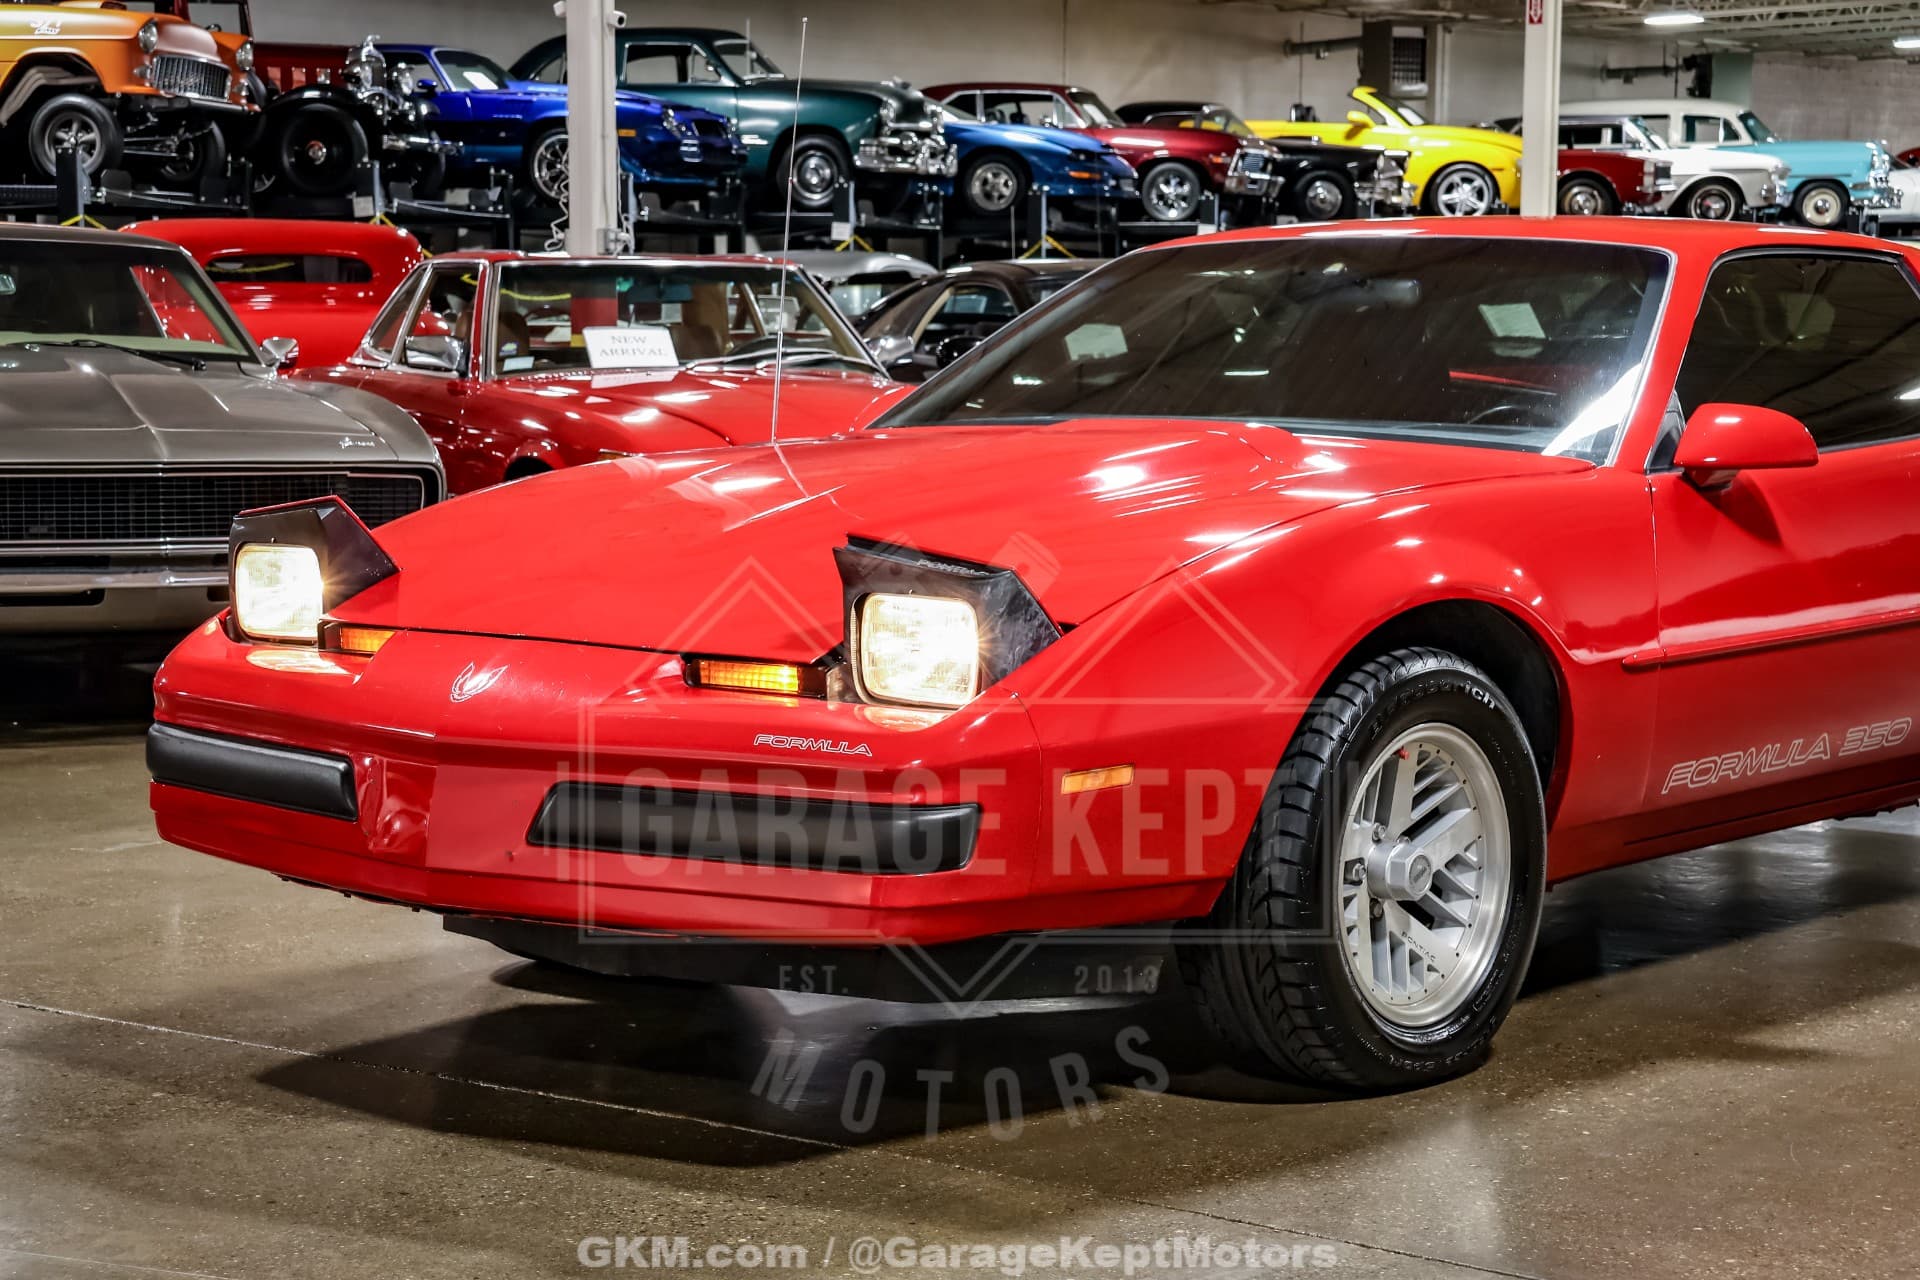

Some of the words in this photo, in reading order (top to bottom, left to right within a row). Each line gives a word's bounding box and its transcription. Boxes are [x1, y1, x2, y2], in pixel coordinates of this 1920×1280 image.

[611, 335, 647, 343] NEW
[600, 348, 668, 356] ARRIVAL
[754, 733, 872, 756] FORMULA
[1661, 733, 1830, 795] FORMULA
[1839, 717, 1912, 756] 350
[1401, 931, 1436, 962] PONTIAC
